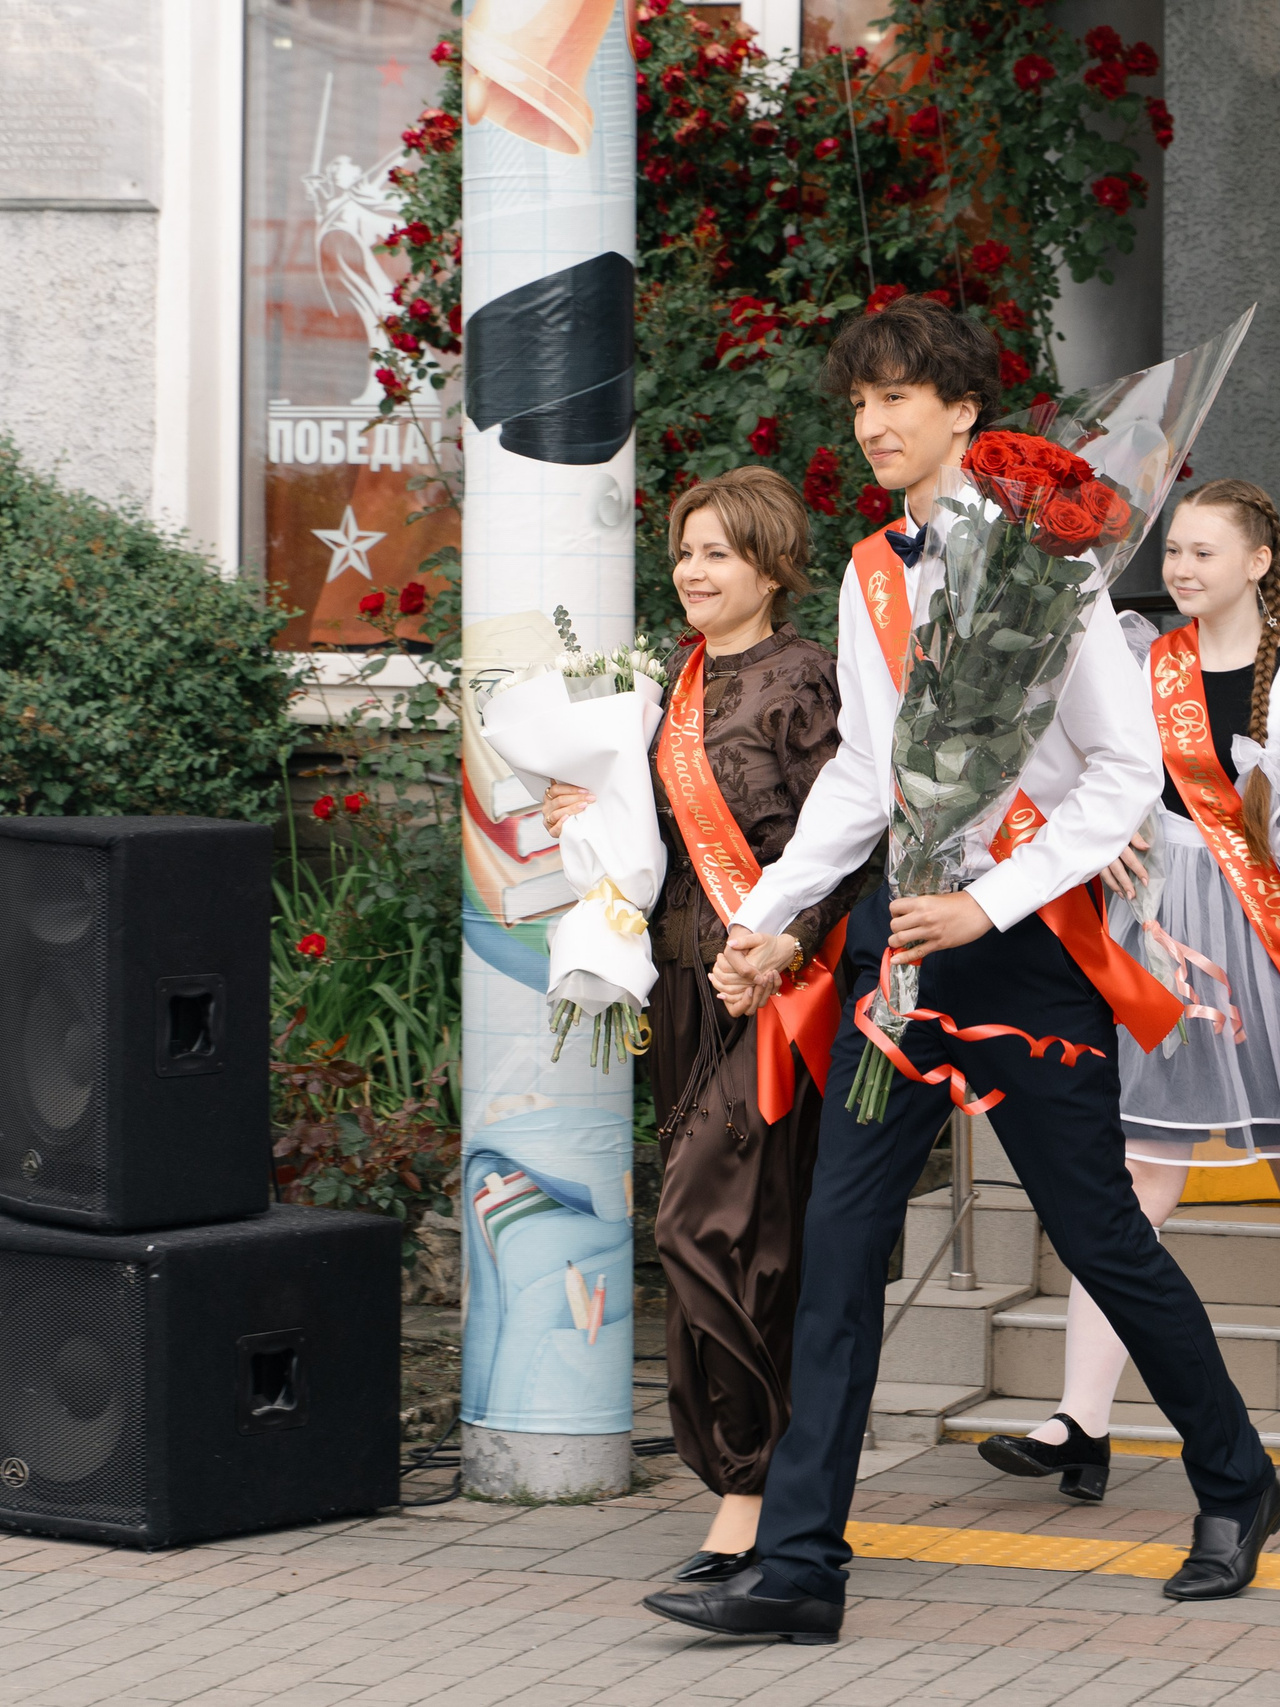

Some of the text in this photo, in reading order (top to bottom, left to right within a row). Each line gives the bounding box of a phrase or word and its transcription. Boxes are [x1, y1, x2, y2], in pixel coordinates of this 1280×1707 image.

[268, 418, 442, 473] ПОБЕДА!
[669, 706, 712, 836] Классный
[1169, 699, 1255, 870] Выпускница
